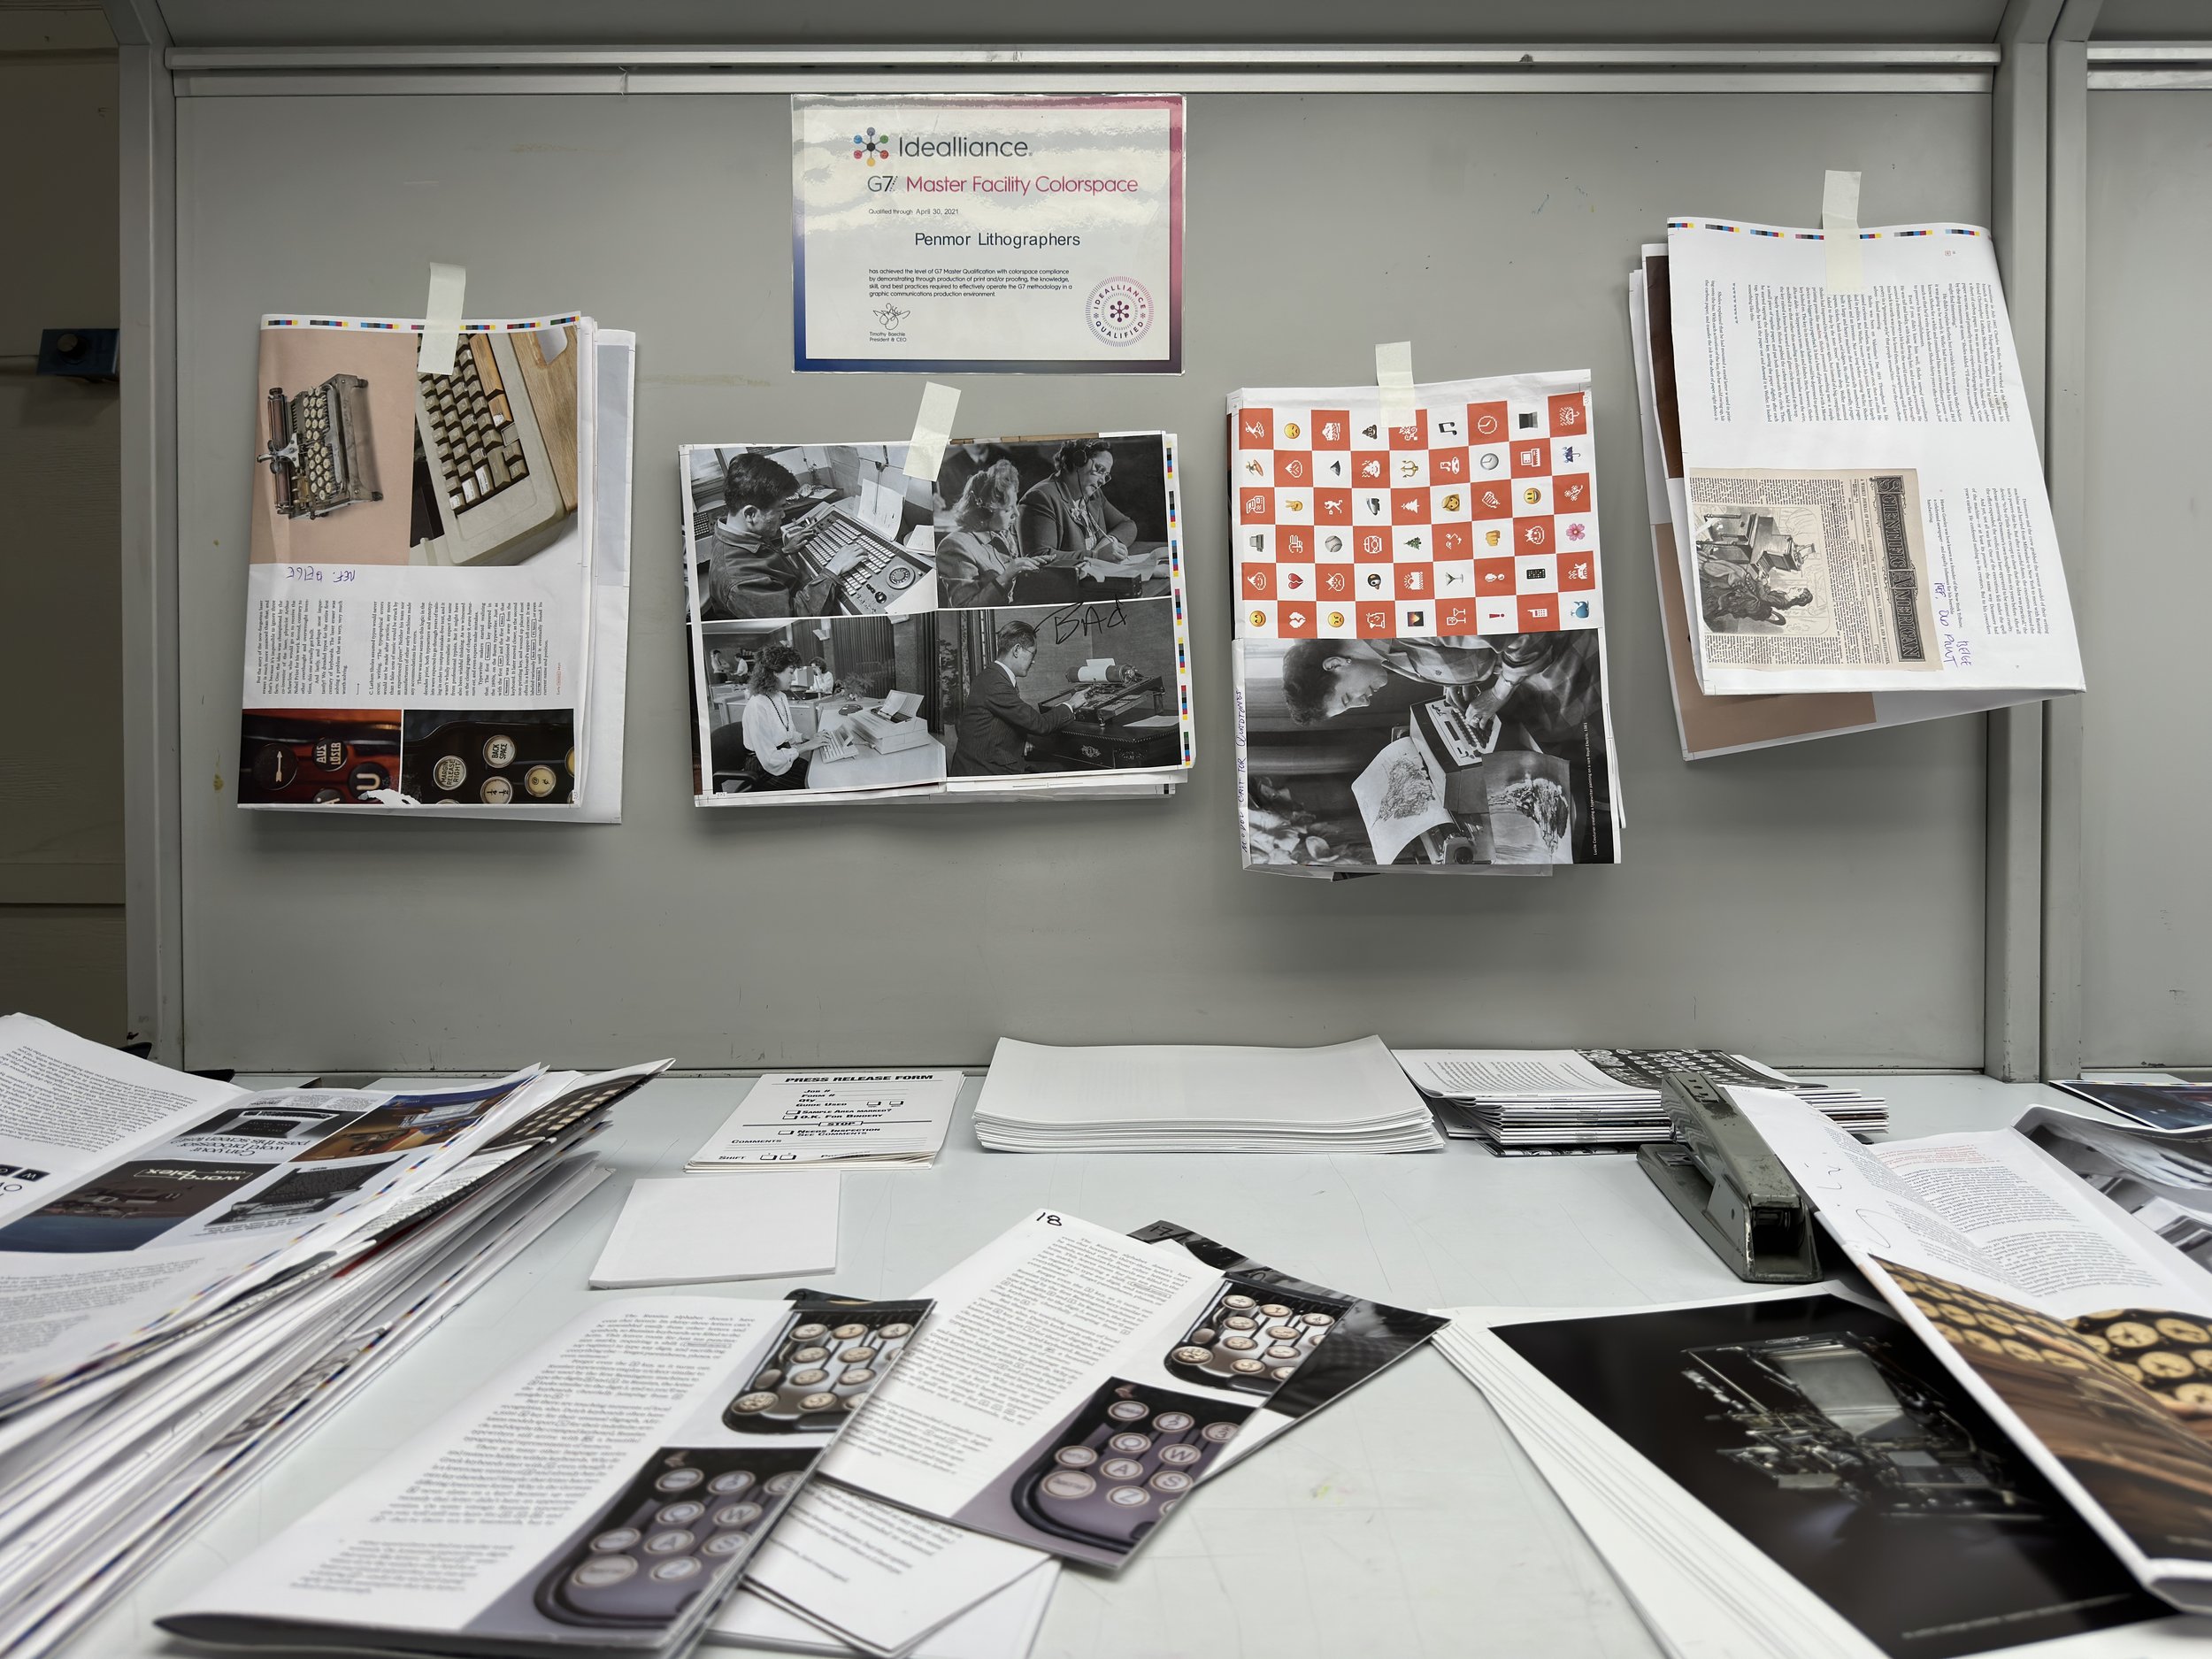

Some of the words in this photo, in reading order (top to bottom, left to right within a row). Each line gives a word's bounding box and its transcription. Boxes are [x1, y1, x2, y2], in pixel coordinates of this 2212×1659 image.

[867, 175, 897, 192] G7
[906, 176, 967, 192] Master
[972, 175, 1030, 196] Facility
[1035, 175, 1138, 196] Colorspace
[915, 232, 971, 245] Penmor
[979, 232, 1079, 249] Lithographers
[1094, 284, 1146, 310] IDEALLIANCE
[1095, 321, 1144, 339] QUALIFIED
[1872, 477, 1908, 567] SCIENTIFIC
[1889, 571, 1921, 658] AMERICAN
[316, 744, 326, 764] AUS
[356, 772, 380, 791] U
[447, 759, 456, 786] RELEASE
[145, 1168, 242, 1182] wordplex
[1036, 1211, 1063, 1227] 18
[1170, 1448, 1194, 1461] W
[1110, 1463, 1129, 1474] A
[1162, 1476, 1182, 1488] S
[1119, 1491, 1141, 1502] Z
